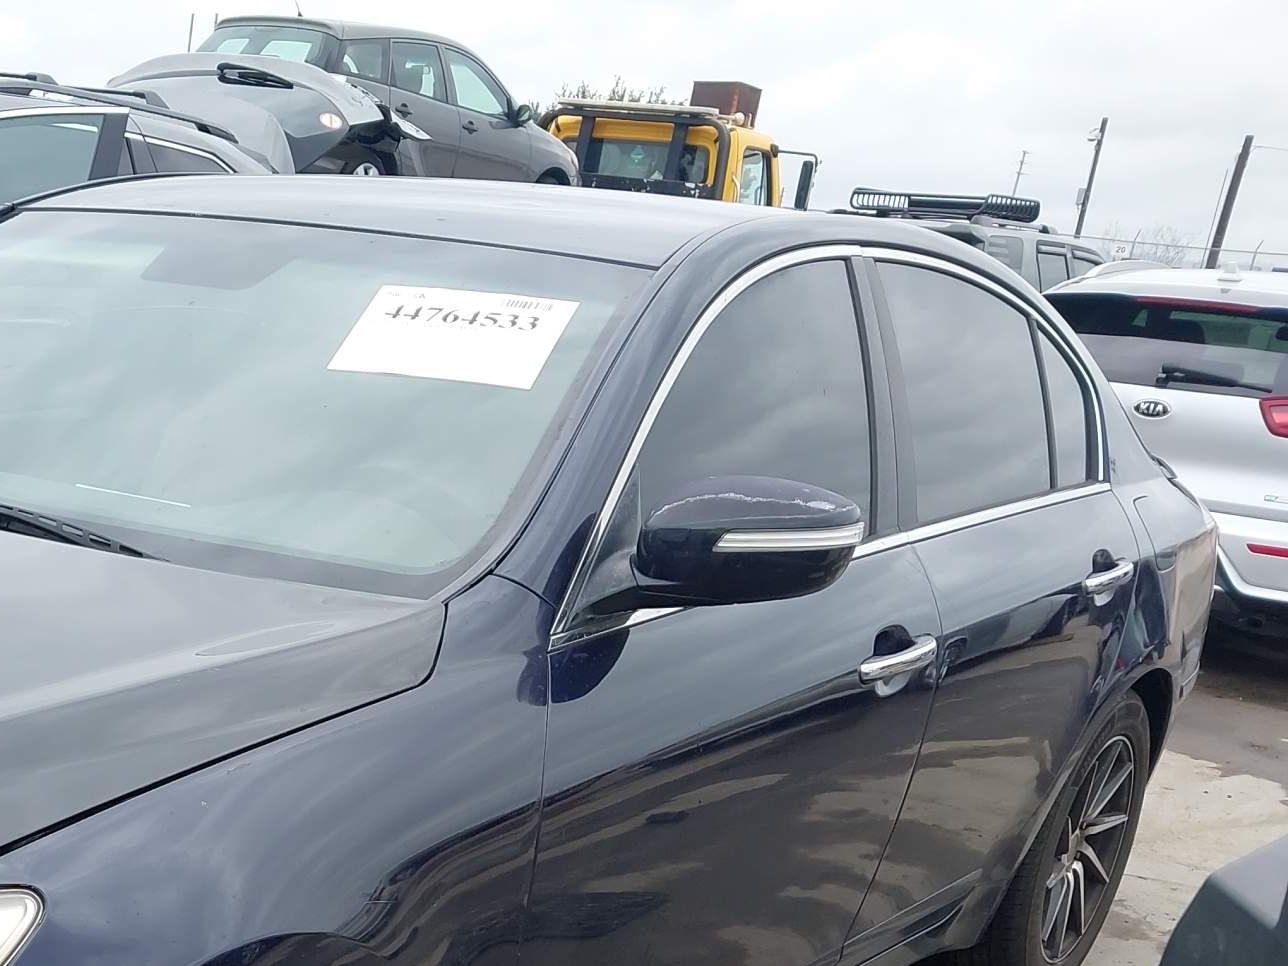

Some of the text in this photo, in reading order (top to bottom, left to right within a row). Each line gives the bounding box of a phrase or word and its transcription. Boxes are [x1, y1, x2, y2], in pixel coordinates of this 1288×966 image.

[1115, 245, 1127, 255] 20
[384, 304, 540, 331] 44764533
[1138, 402, 1165, 417] KIA
